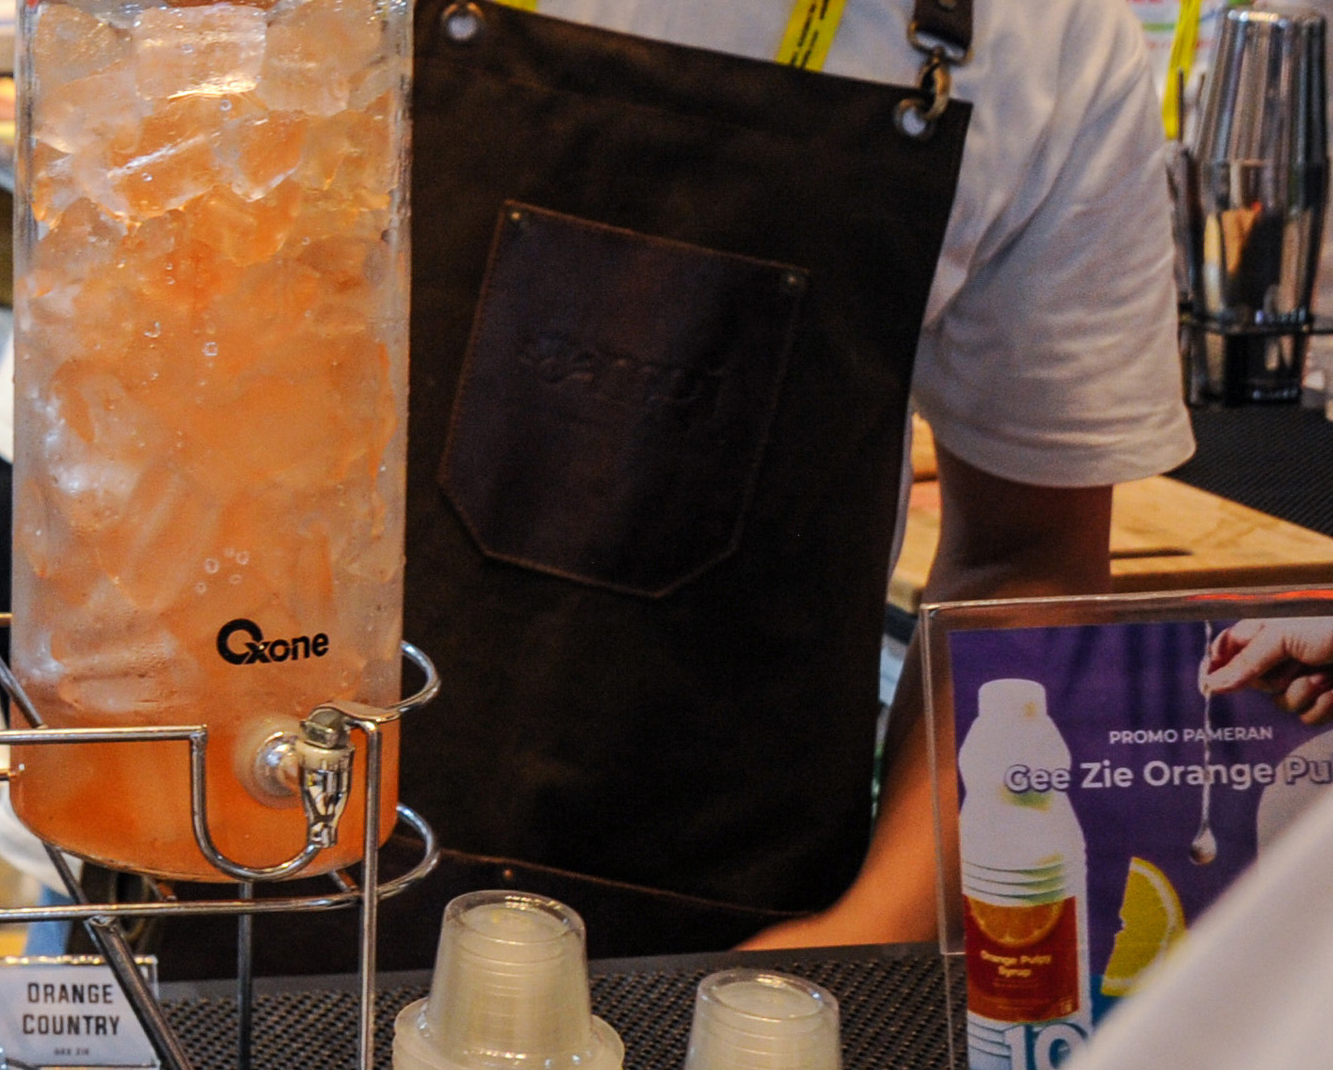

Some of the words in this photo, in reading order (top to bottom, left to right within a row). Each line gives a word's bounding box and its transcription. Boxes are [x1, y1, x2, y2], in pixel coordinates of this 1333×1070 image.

[216, 618, 330, 665] Qxone
[1109, 729, 1178, 744] PROMO
[1183, 726, 1273, 742] PAMERAN
[1005, 764, 1070, 793] Gee
[1079, 760, 1134, 789] Zie
[1143, 760, 1274, 790] Orange
[27, 982, 114, 1004] ORANGE
[22, 1014, 120, 1036] COUNTRY
